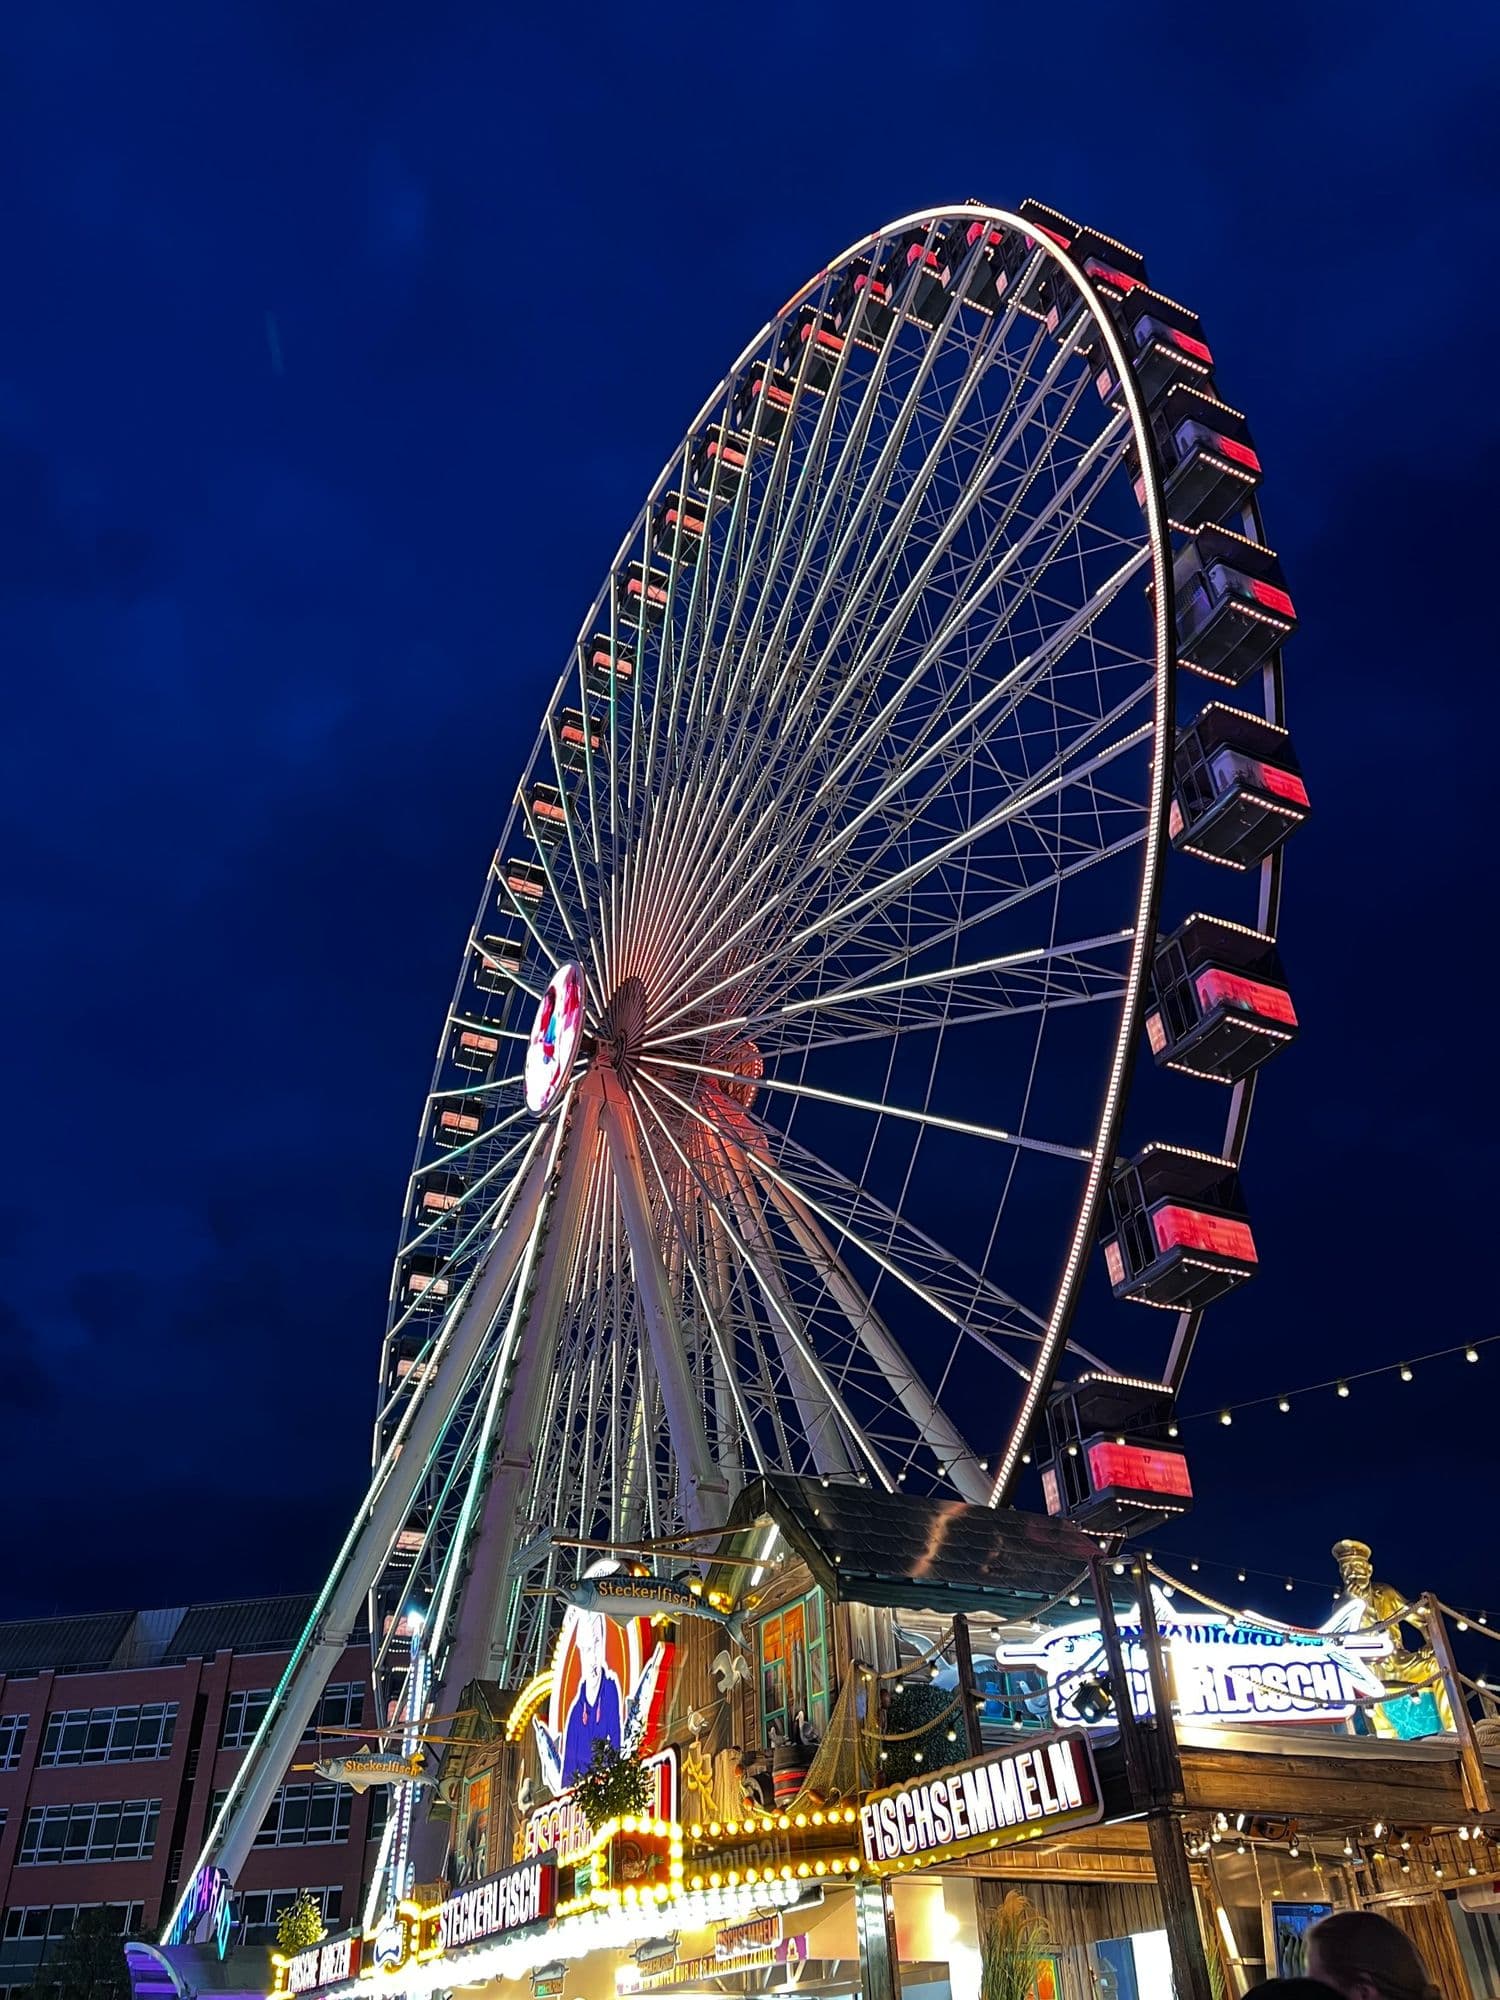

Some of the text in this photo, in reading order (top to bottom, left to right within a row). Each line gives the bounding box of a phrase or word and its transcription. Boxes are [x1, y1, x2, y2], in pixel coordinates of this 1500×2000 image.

[599, 1581, 697, 1609] Steckerlfisch
[345, 1760, 418, 1777] Steckerlfisch
[860, 1740, 1082, 1862] FISCHSEMMELN
[439, 1863, 541, 1949] STECKERLFISCH
